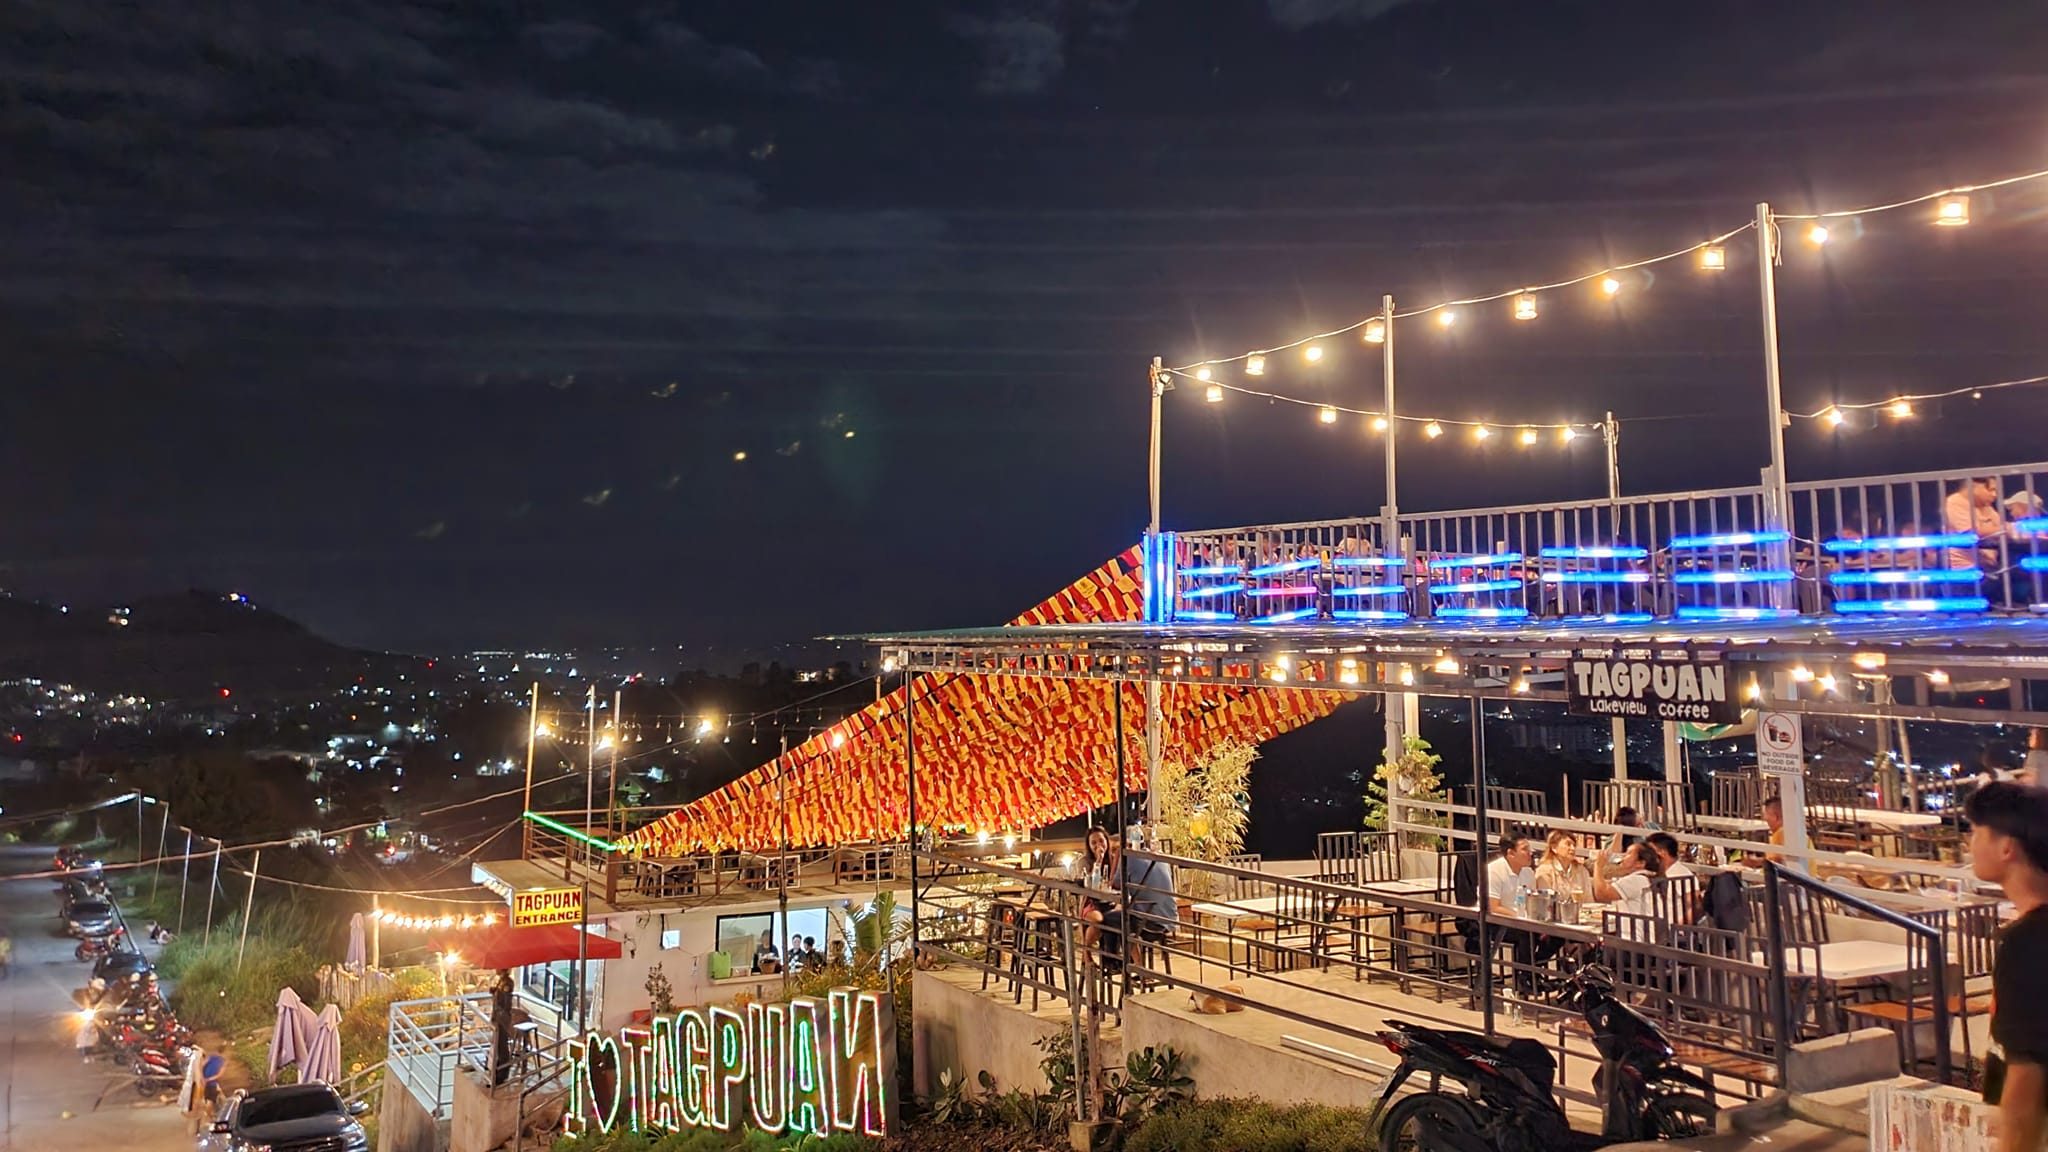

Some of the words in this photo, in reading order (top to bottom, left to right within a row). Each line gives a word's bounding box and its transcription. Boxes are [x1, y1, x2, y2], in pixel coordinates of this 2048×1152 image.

[1573, 661, 1726, 702] TAGPUAN
[516, 891, 581, 912] TAGPUAN
[515, 910, 581, 925] ENTRANCE
